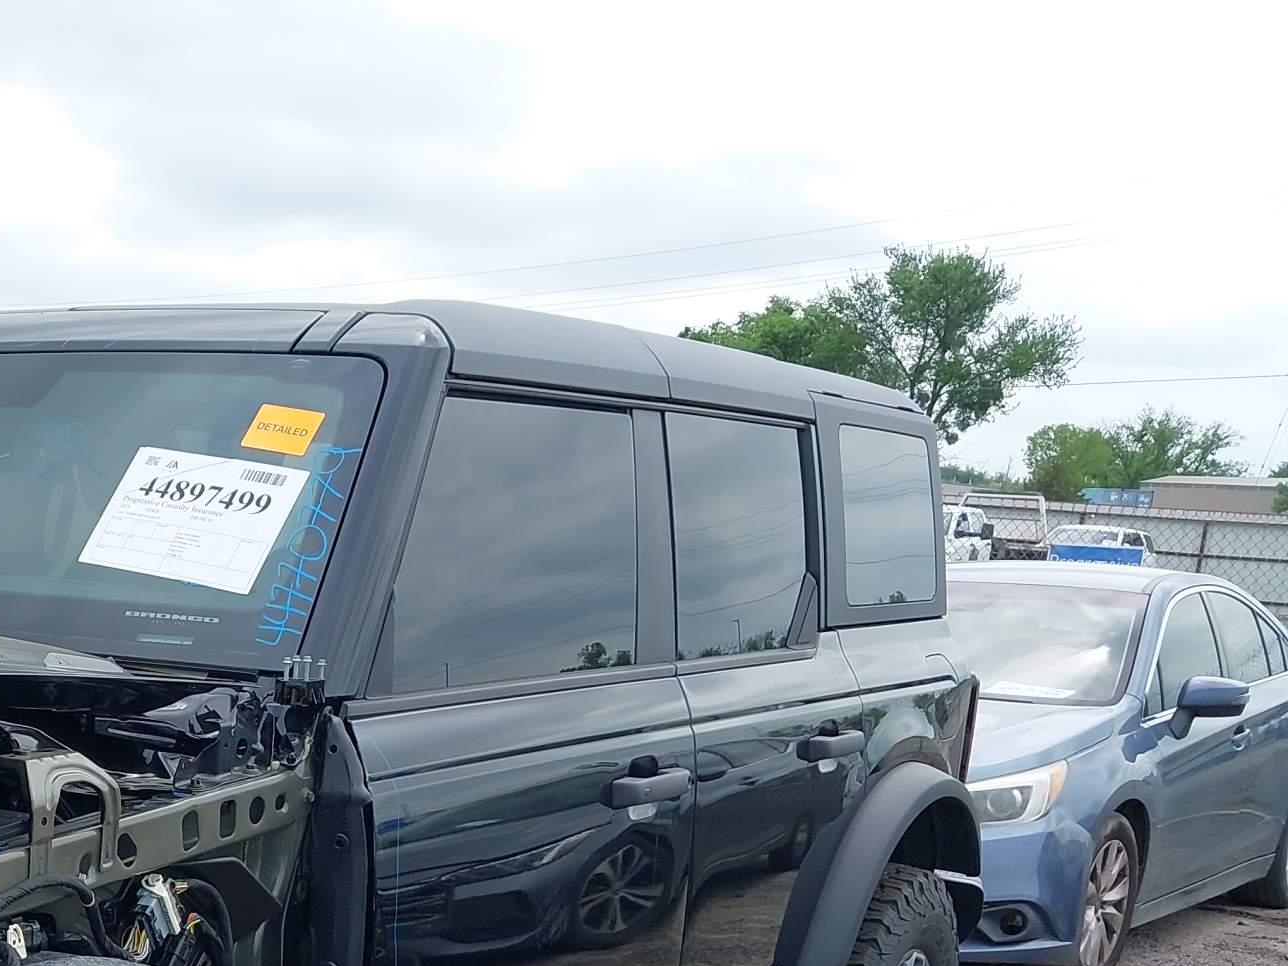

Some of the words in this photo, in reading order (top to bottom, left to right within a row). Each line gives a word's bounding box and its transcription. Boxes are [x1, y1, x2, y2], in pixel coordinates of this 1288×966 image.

[257, 421, 309, 437] DETAILED
[139, 477, 272, 515] 44897499
[125, 610, 220, 623] BRONCO
